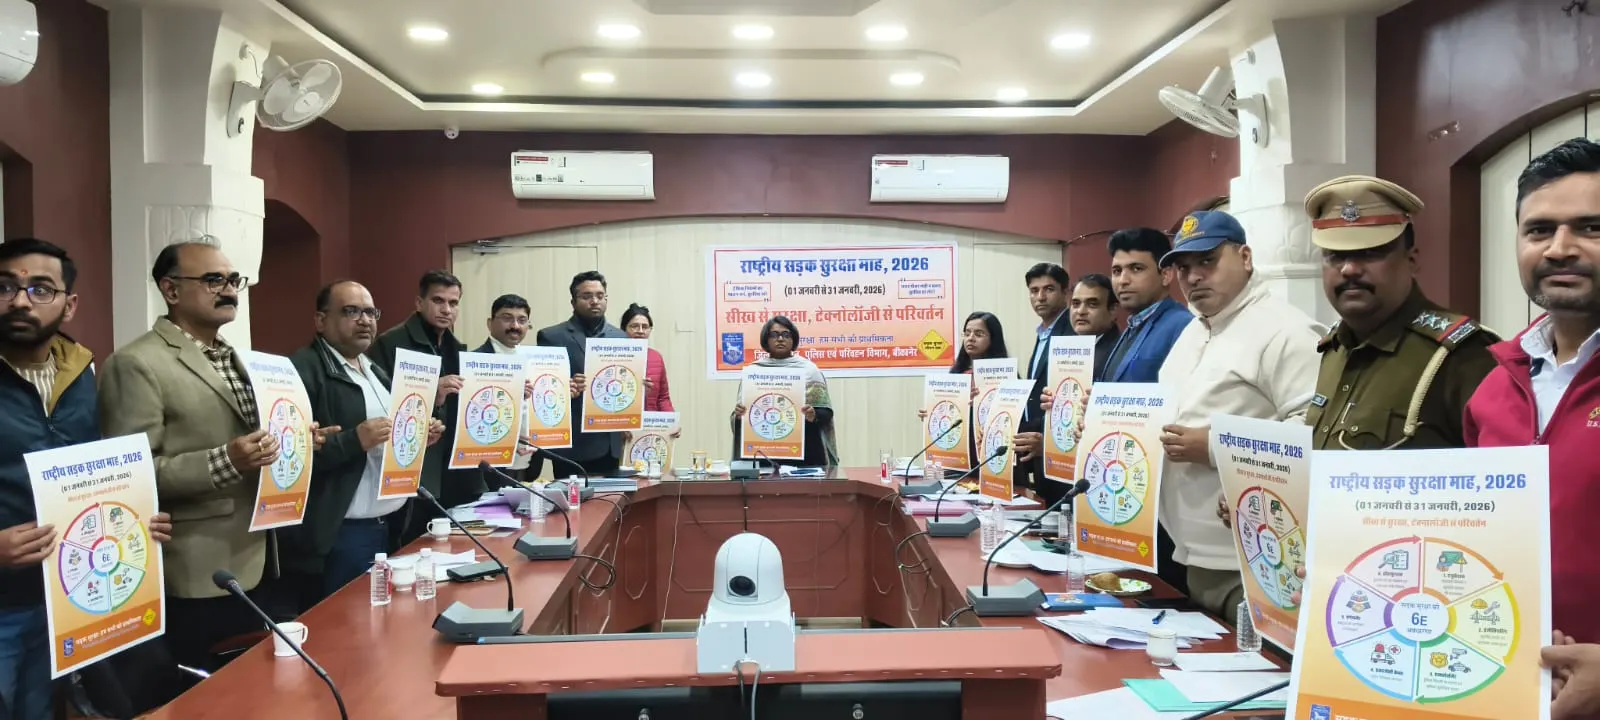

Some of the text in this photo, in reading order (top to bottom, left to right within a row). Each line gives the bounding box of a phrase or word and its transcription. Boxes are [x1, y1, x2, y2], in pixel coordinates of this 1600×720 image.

[740, 256, 928, 277] राष्ट्रीय सड़क सुरक्षा माह, 2026
[799, 285, 820, 295] जनवरी
[838, 284, 862, 296] जनवरी,
[864, 284, 886, 295] 2026)
[726, 308, 756, 323] सीख
[758, 307, 769, 322] से
[816, 306, 880, 322] टेक्नोलॉजी
[882, 306, 892, 321] से
[896, 304, 944, 320] परिवर्तन
[1284, 444, 1302, 458] 2026
[42, 466, 65, 480] राष्ट्रीय
[66, 463, 85, 477] सड़क
[123, 452, 143, 464] 2026
[1330, 472, 1526, 494] राष्ट्रीय सड़क सुरक्षा माह, 2026
[1374, 500, 1402, 510] जनवरी
[1464, 500, 1496, 512] 2026)
[1412, 612, 1428, 626] 6E
